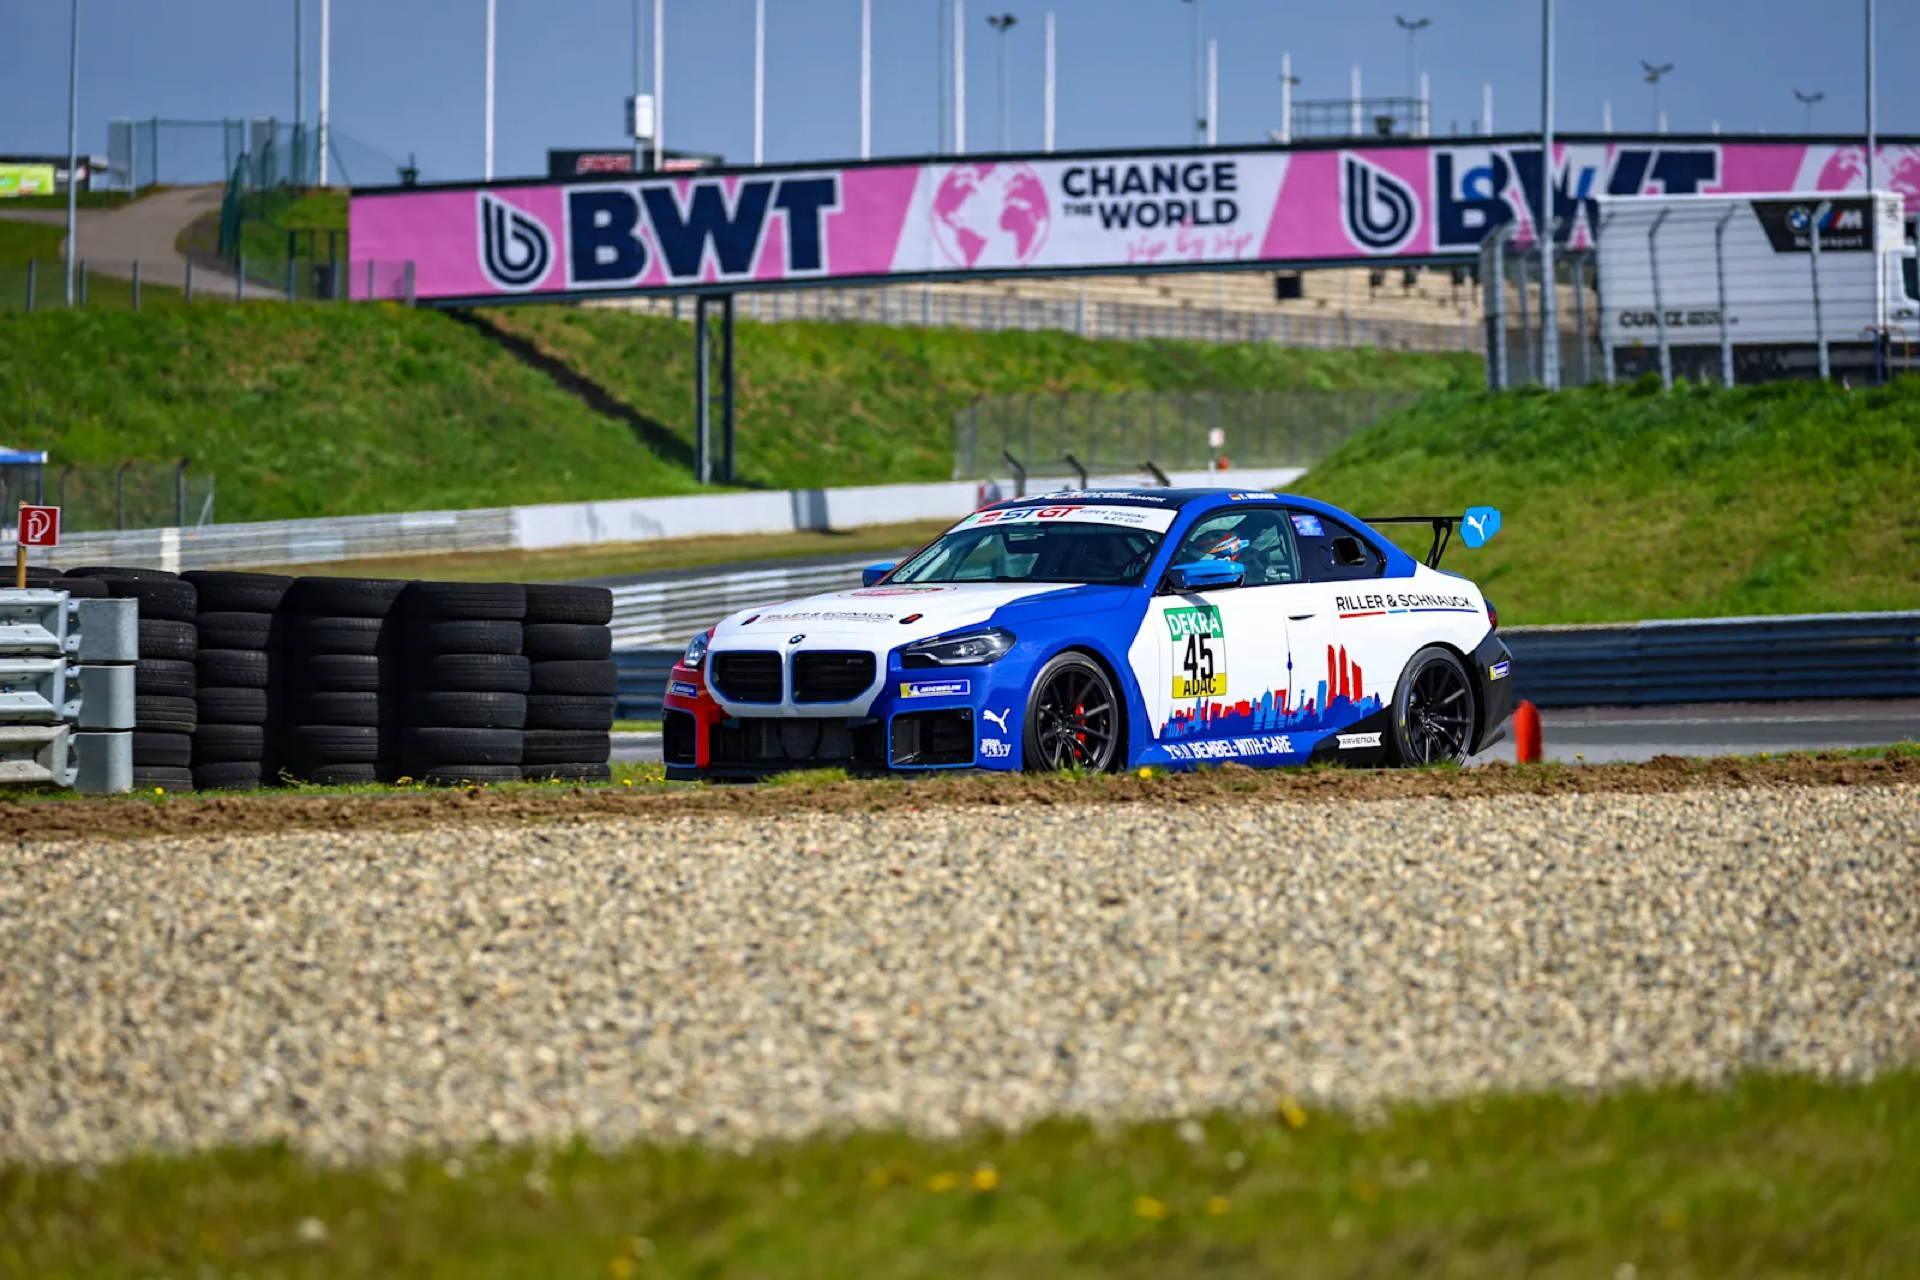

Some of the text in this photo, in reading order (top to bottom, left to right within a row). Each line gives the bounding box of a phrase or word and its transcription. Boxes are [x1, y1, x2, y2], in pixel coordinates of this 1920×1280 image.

[1061, 161, 1238, 199] CHANGE
[568, 177, 836, 283] BWT
[1063, 199, 1240, 230] THE WORLD
[1336, 594, 1476, 611] RILLER & SCHNAUCK
[1166, 611, 1221, 636] DEKRA
[1183, 632, 1214, 681] 45
[1183, 678, 1217, 696] ADAC
